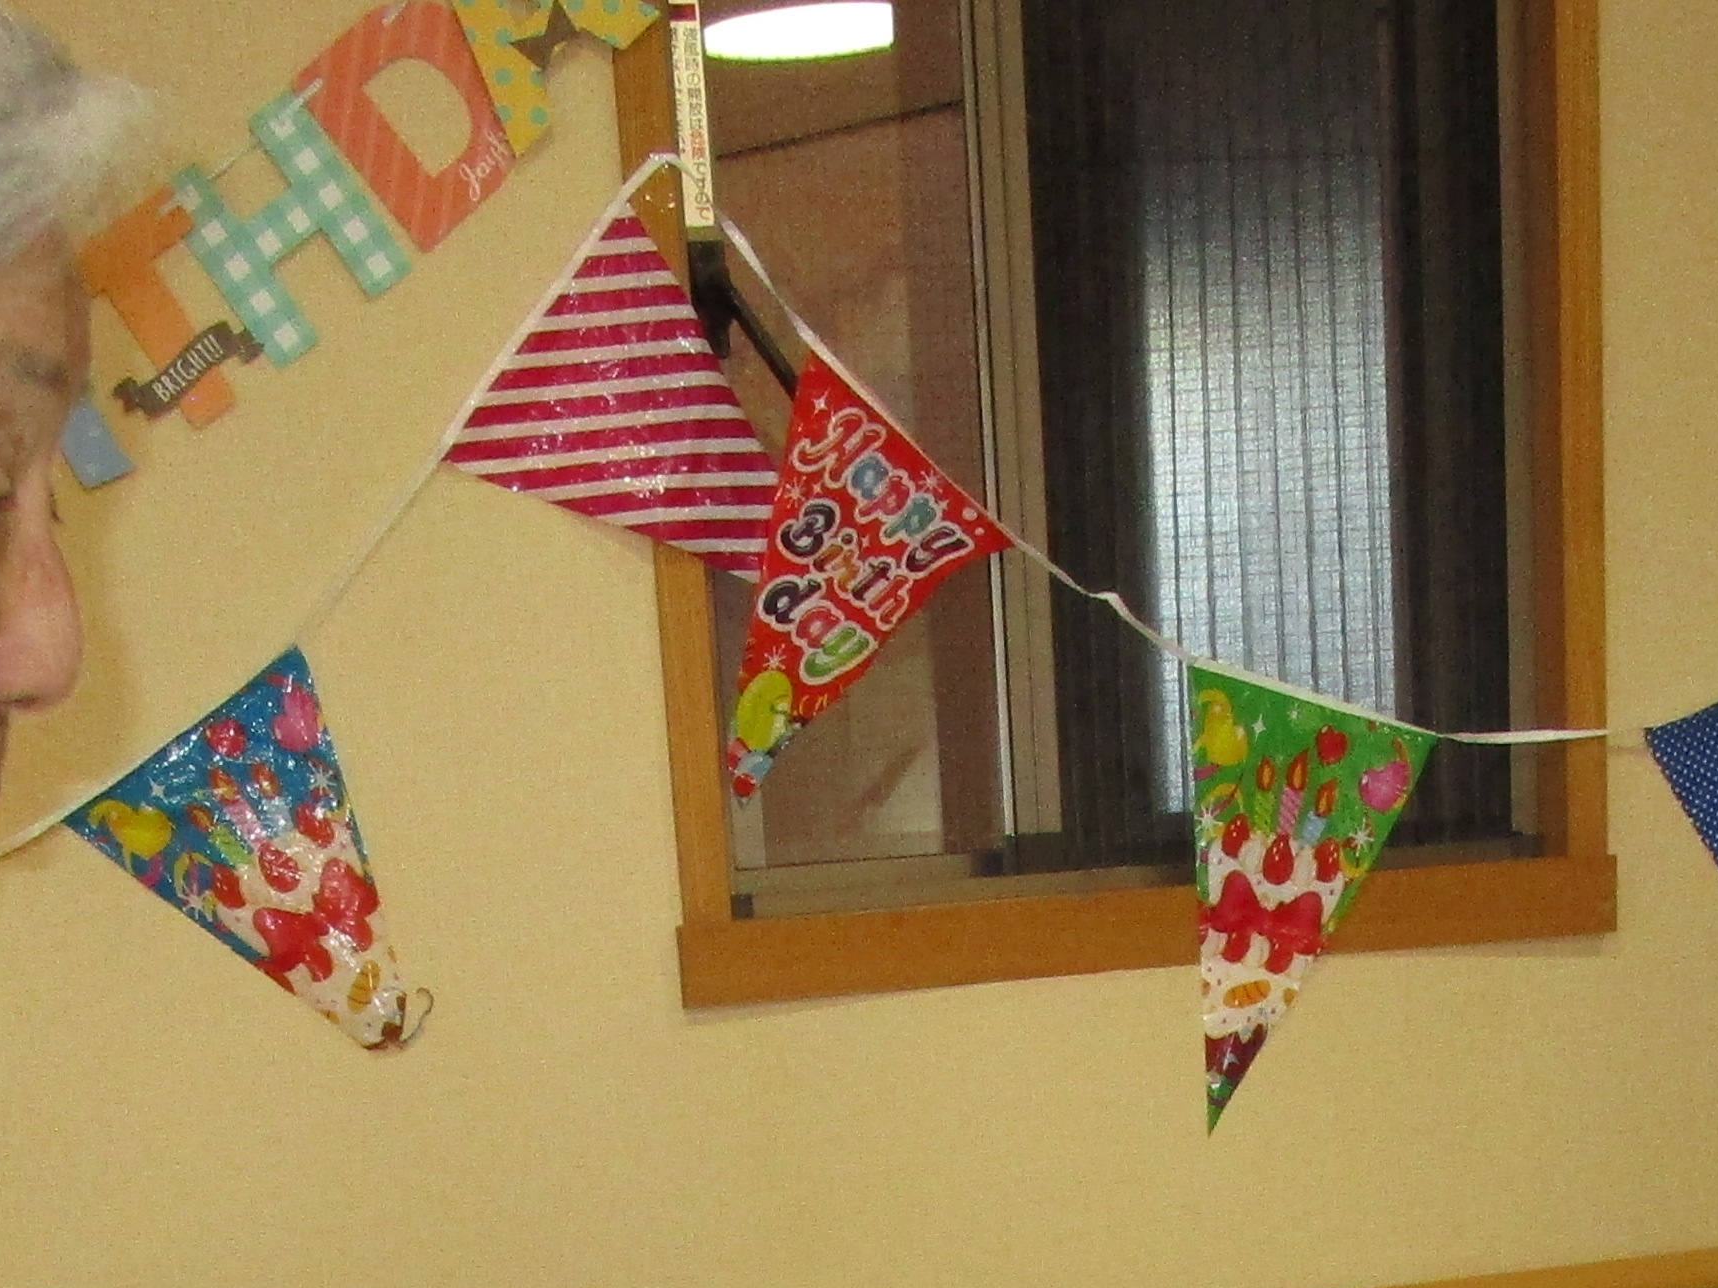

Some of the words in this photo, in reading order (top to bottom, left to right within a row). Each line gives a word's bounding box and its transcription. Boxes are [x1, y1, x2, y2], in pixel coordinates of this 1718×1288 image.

[791, 407, 976, 580] Happy
[756, 573, 878, 686] day
[776, 497, 915, 632] Birth
